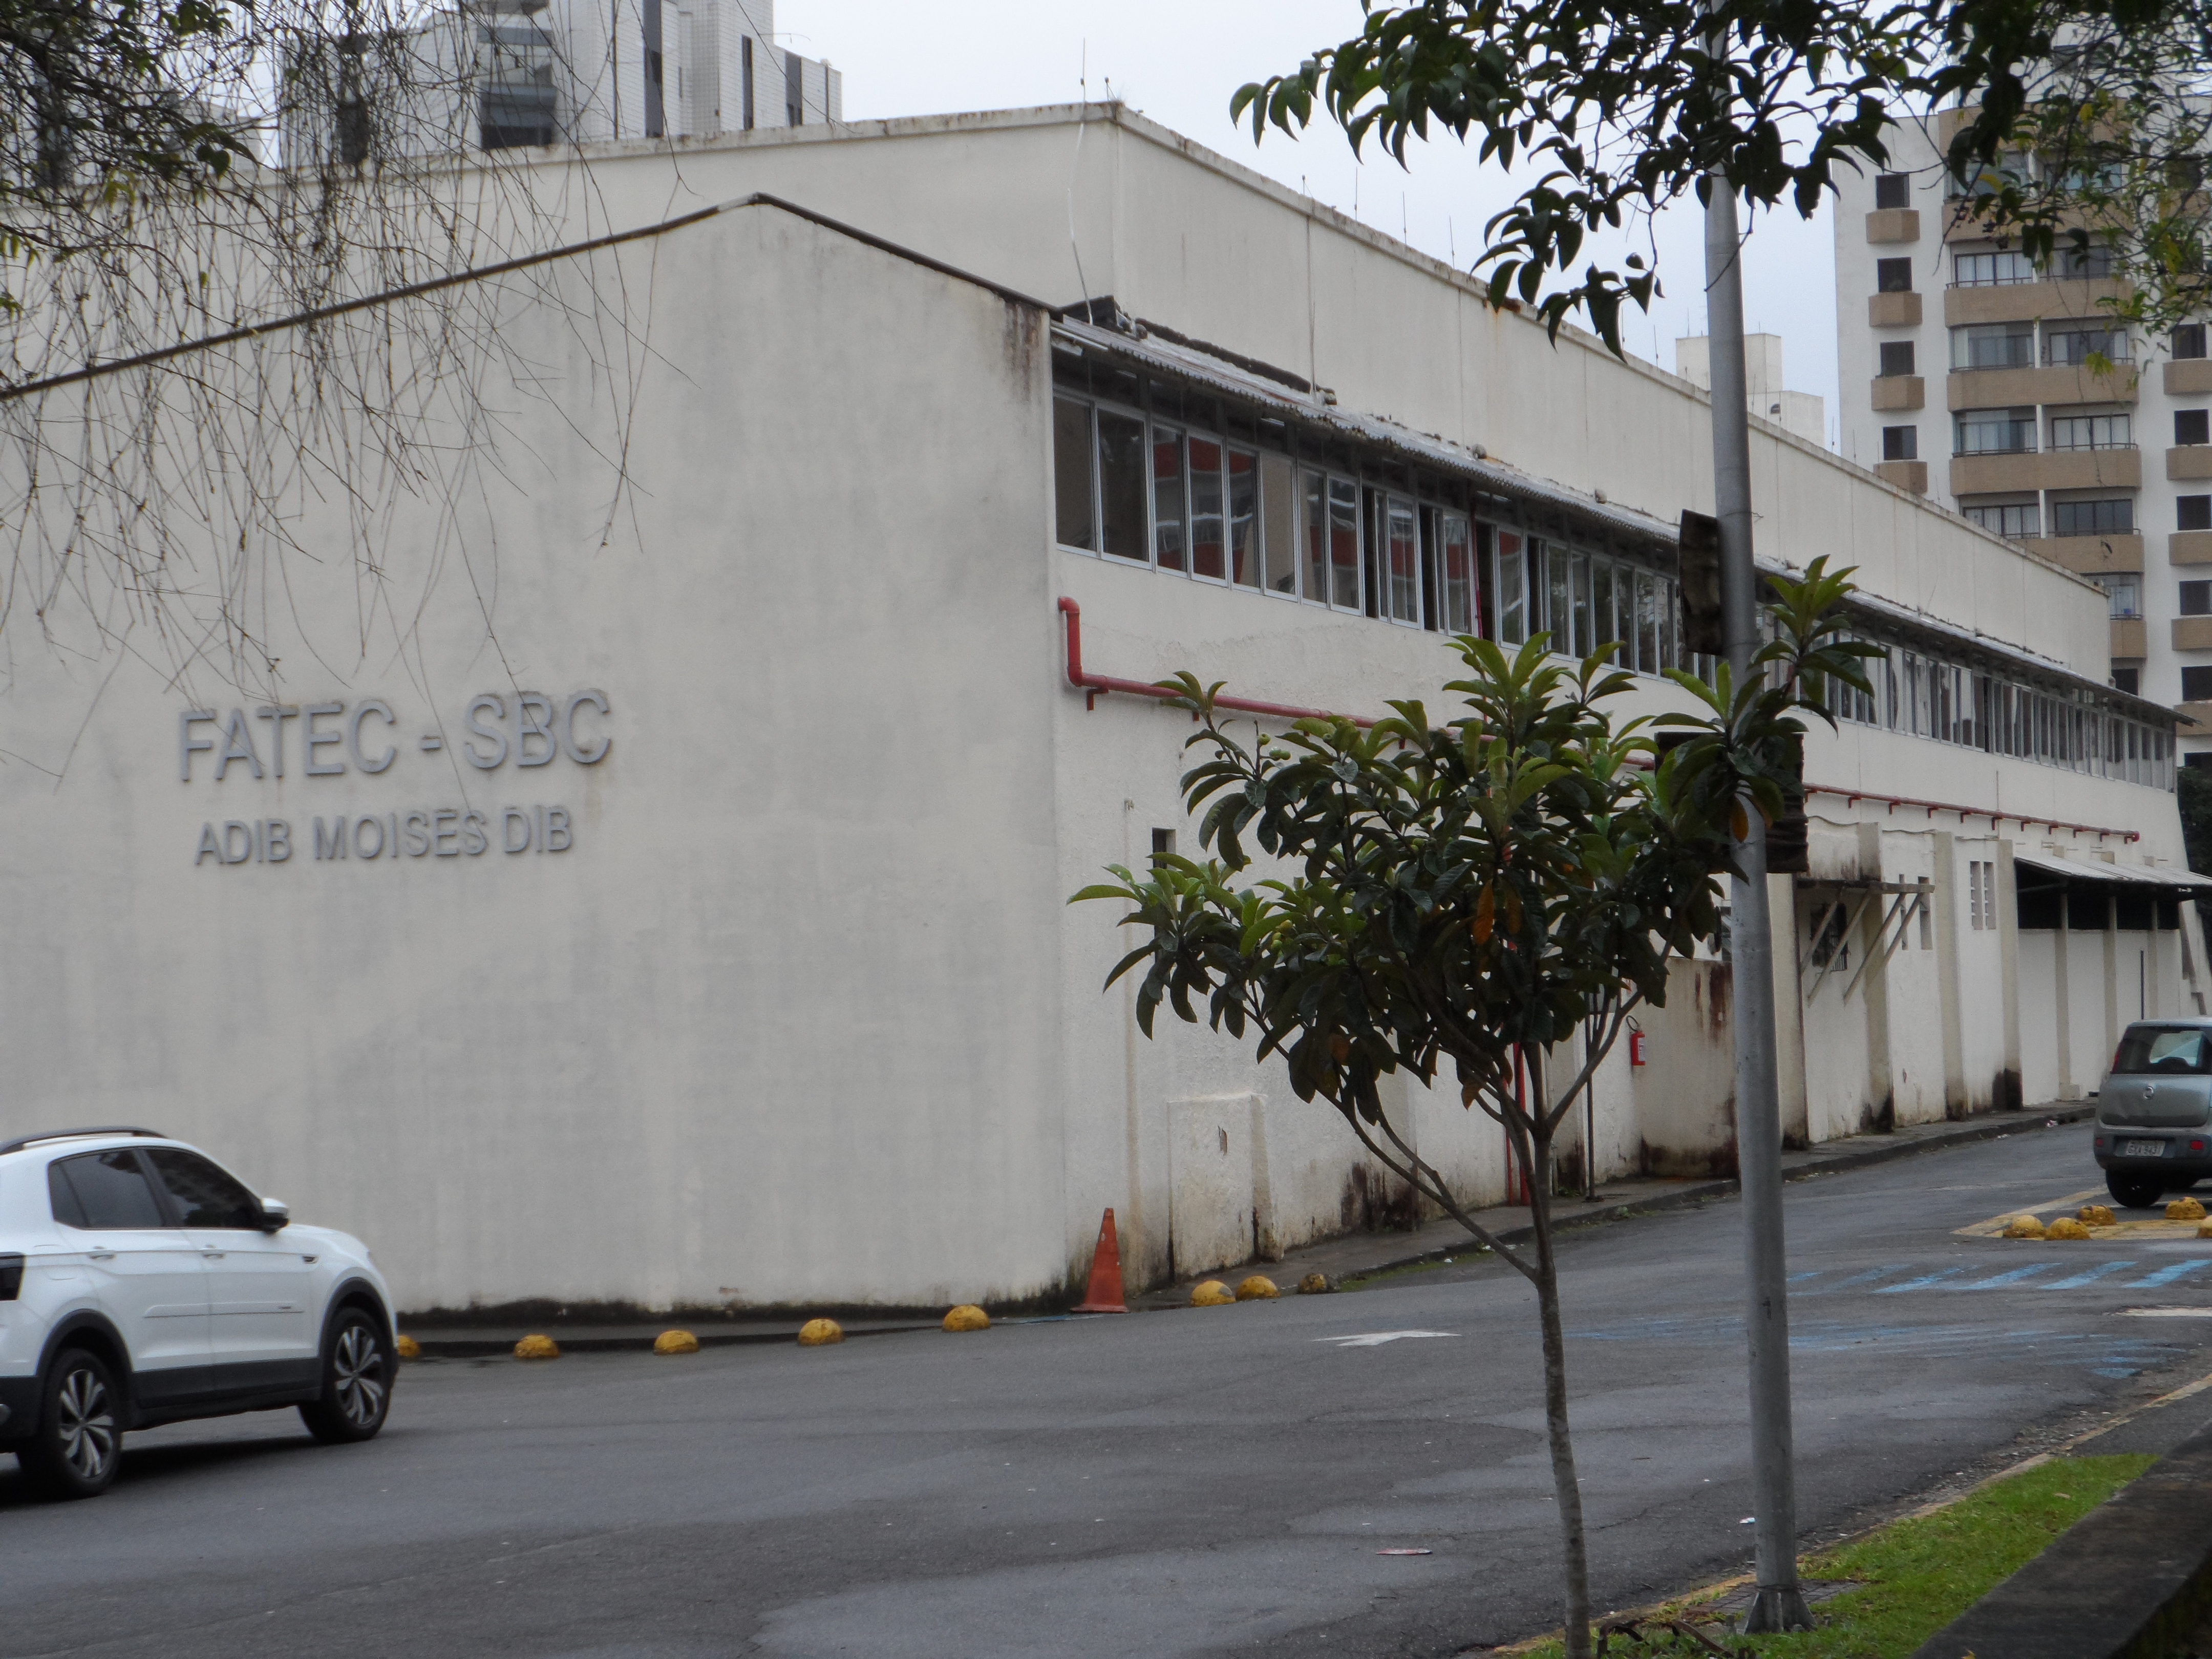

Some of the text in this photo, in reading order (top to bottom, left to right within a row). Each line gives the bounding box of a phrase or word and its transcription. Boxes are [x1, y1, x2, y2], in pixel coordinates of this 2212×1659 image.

[179, 699, 396, 782] FATEC
[465, 689, 611, 770] SBC
[195, 805, 573, 865] ADIB MOISES DIB
